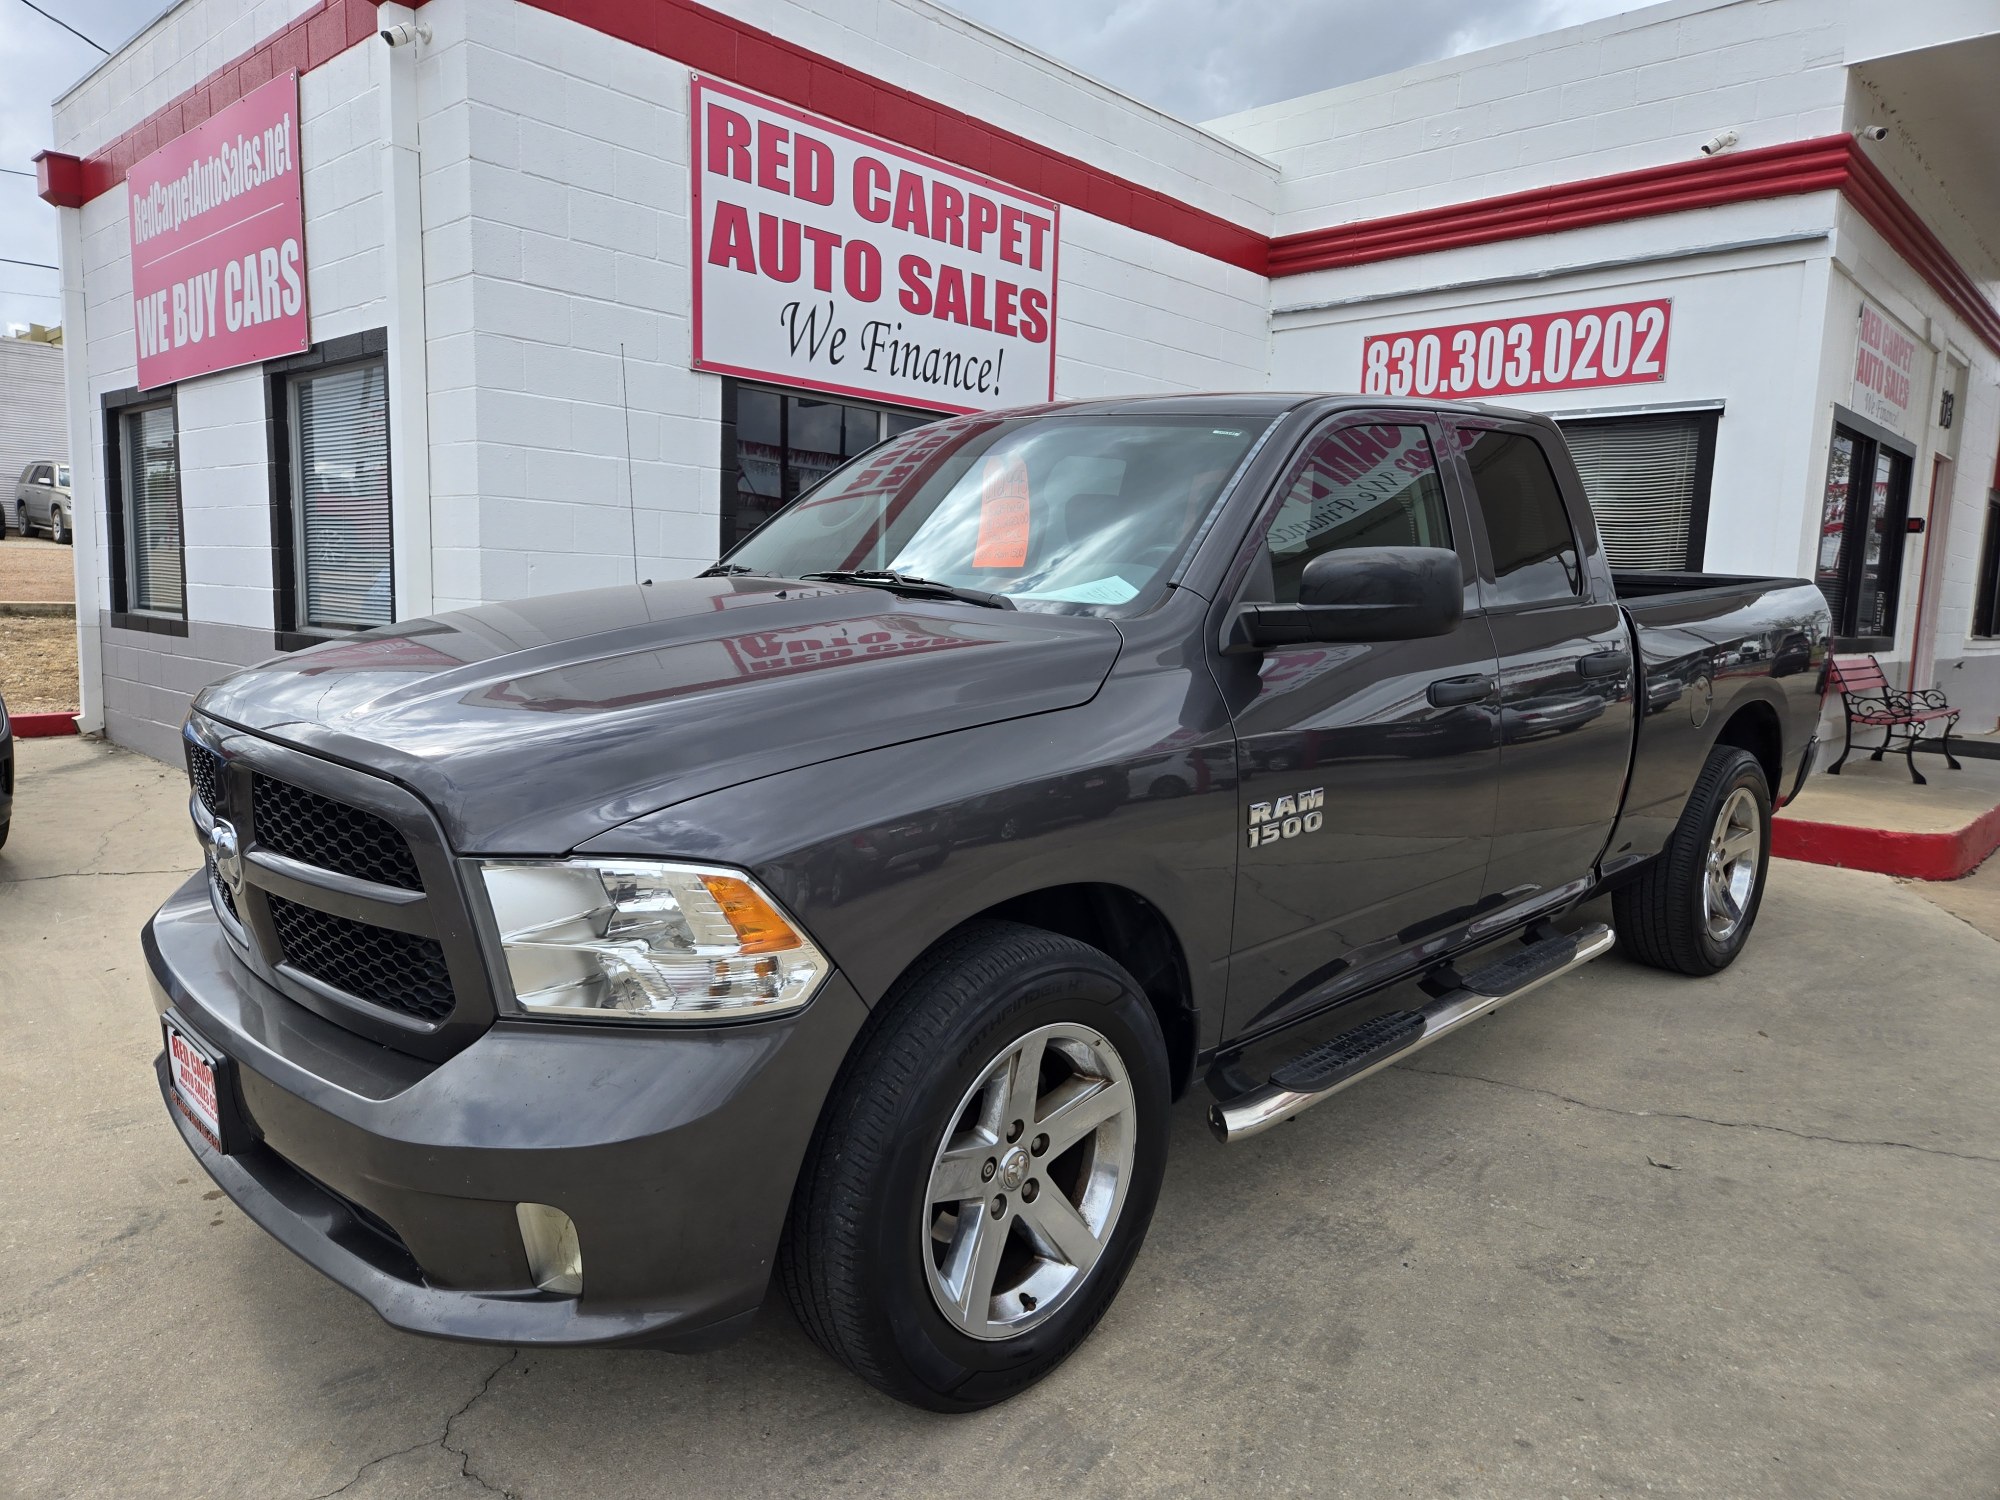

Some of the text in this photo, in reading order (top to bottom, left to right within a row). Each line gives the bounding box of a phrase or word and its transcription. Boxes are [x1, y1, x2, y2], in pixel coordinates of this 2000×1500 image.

[134, 112, 292, 245] RedCarpetAutoSales.net
[707, 102, 1051, 272] RED CARPET
[136, 238, 302, 359] WE BUY CARS
[707, 200, 1048, 344] AUTO SALES
[780, 300, 1004, 396] We Finance!
[1364, 306, 1666, 397] 830.303.0202
[1856, 347, 1910, 411] AUTO SALES
[1861, 307, 1915, 374] RED CARPET
[1248, 787, 1324, 826] RAM
[1248, 811, 1323, 849] 1500
[171, 1035, 190, 1068] RED
